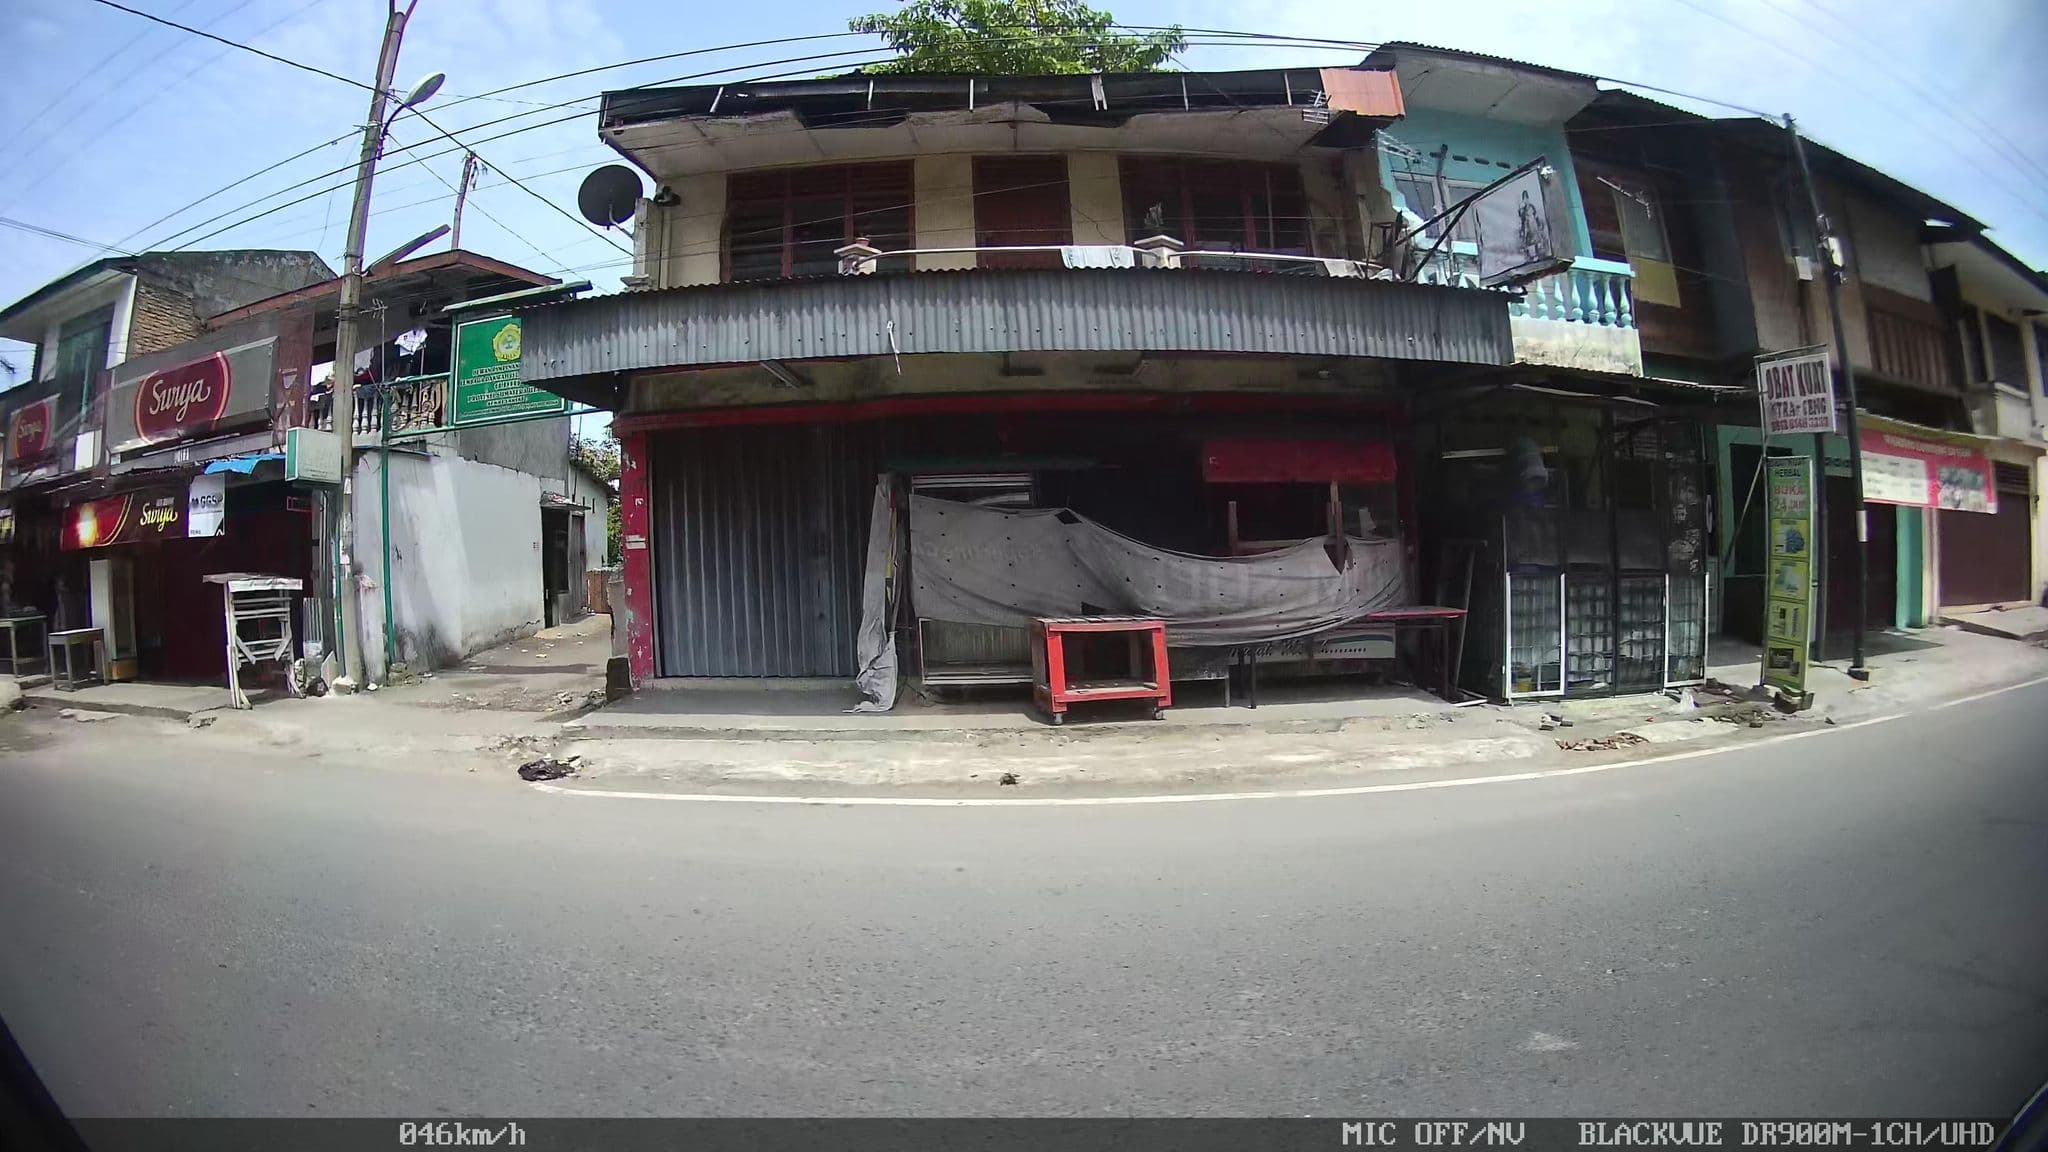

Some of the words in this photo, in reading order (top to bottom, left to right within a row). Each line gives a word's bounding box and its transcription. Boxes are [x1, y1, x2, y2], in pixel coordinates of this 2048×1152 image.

[1796, 360, 1827, 397] KUAT
[149, 378, 212, 422] Surya
[140, 502, 178, 532] Surya
